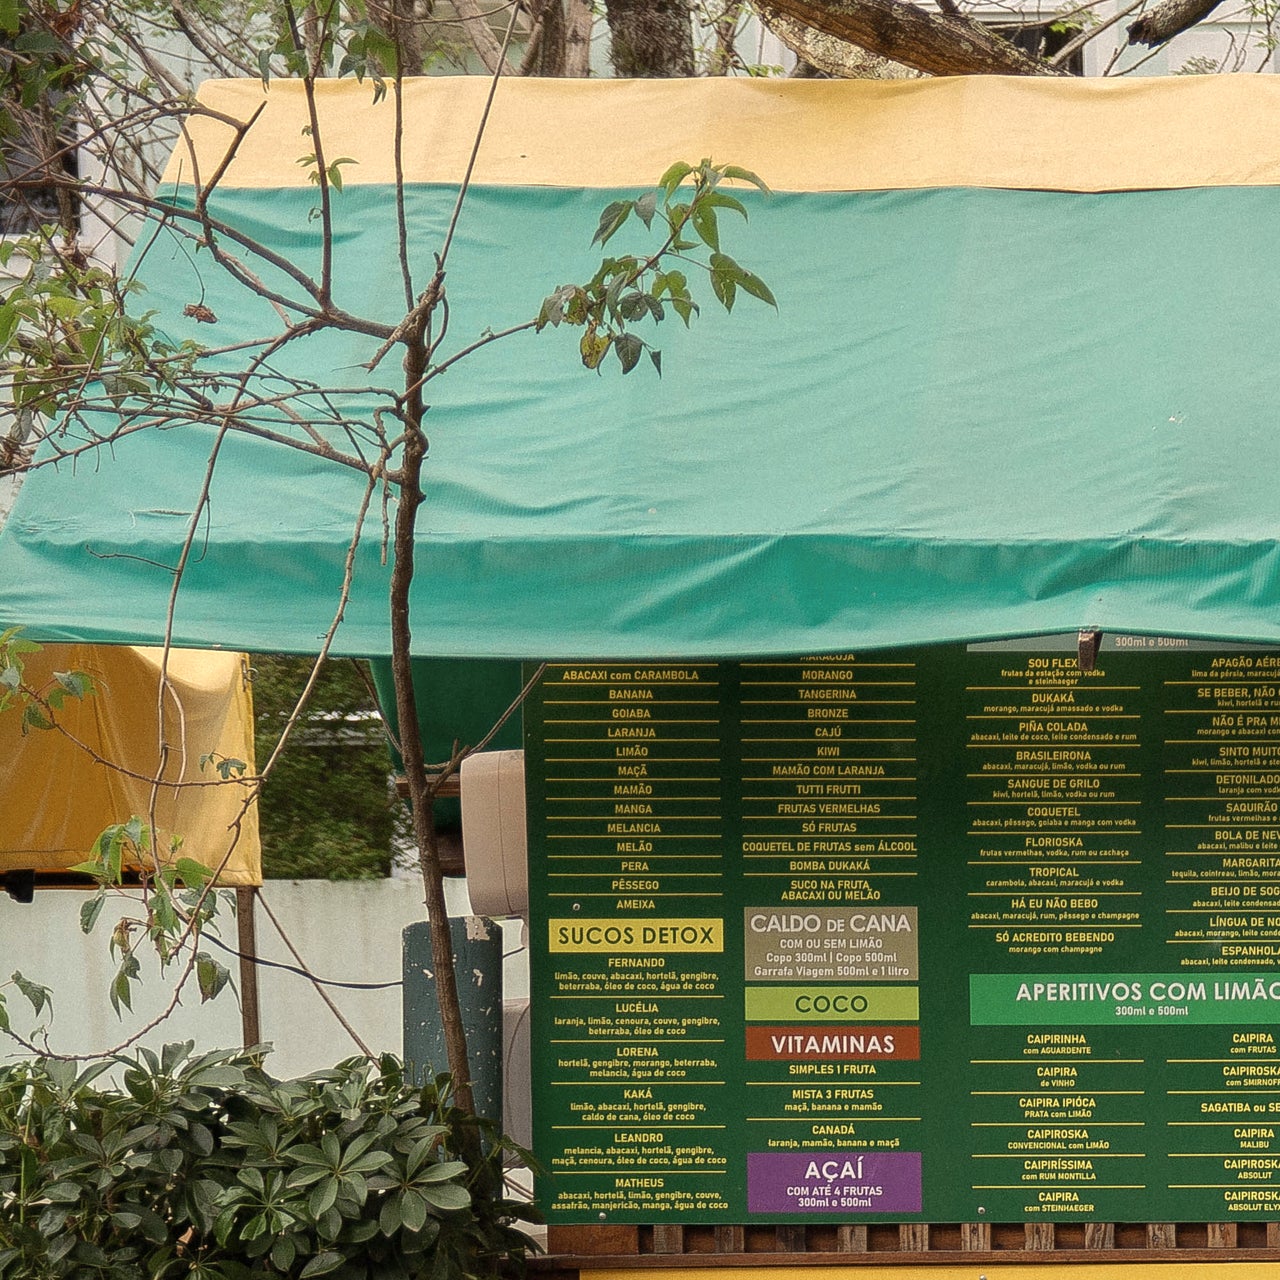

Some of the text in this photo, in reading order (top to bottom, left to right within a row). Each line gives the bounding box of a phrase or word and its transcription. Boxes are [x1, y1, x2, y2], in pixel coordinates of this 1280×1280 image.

[563, 671, 607, 680] ABACAXI
[634, 671, 698, 680] CARAMBOLA
[803, 671, 853, 680] MORANGO
[609, 690, 653, 699] BANANA
[799, 690, 856, 699] TANGERINA
[1032, 691, 1074, 702] DUKAKÁ
[1019, 720, 1088, 731] PIÑA COLADA
[608, 728, 656, 737] LARANJA
[815, 725, 841, 737] CAJÚ
[616, 745, 648, 756] LIMÃO
[1220, 747, 1249, 756] SINTO
[1016, 751, 1091, 760] BRASILEIRONA
[773, 764, 884, 775] MAMÃO COM LARANJA
[614, 783, 652, 794] MAMÃO
[797, 785, 860, 794] TUTTI FRUTTI
[615, 804, 652, 813] MANGA
[617, 900, 655, 908] AMEIXA
[751, 914, 911, 932] CALDO DE CANA
[559, 927, 713, 944] SUCOS DETOX
[609, 958, 664, 967] FERNANDO
[1016, 983, 1141, 1000] APERITIVOS
[1150, 983, 1206, 1000] COM
[616, 1001, 658, 1012] LUCÉLIA
[796, 996, 867, 1013] COCO
[1116, 1006, 1146, 1015] 300ml
[1158, 1006, 1188, 1015] 500ml
[1028, 1035, 1086, 1043] CAIPIRINHA
[1233, 1034, 1273, 1043] CAIPIRA
[772, 1036, 894, 1053] VITAMINAS
[624, 1087, 652, 1098] KAKÁ
[1201, 1103, 1250, 1112] SAGATIBA
[805, 1156, 863, 1182] AÇAÍ
